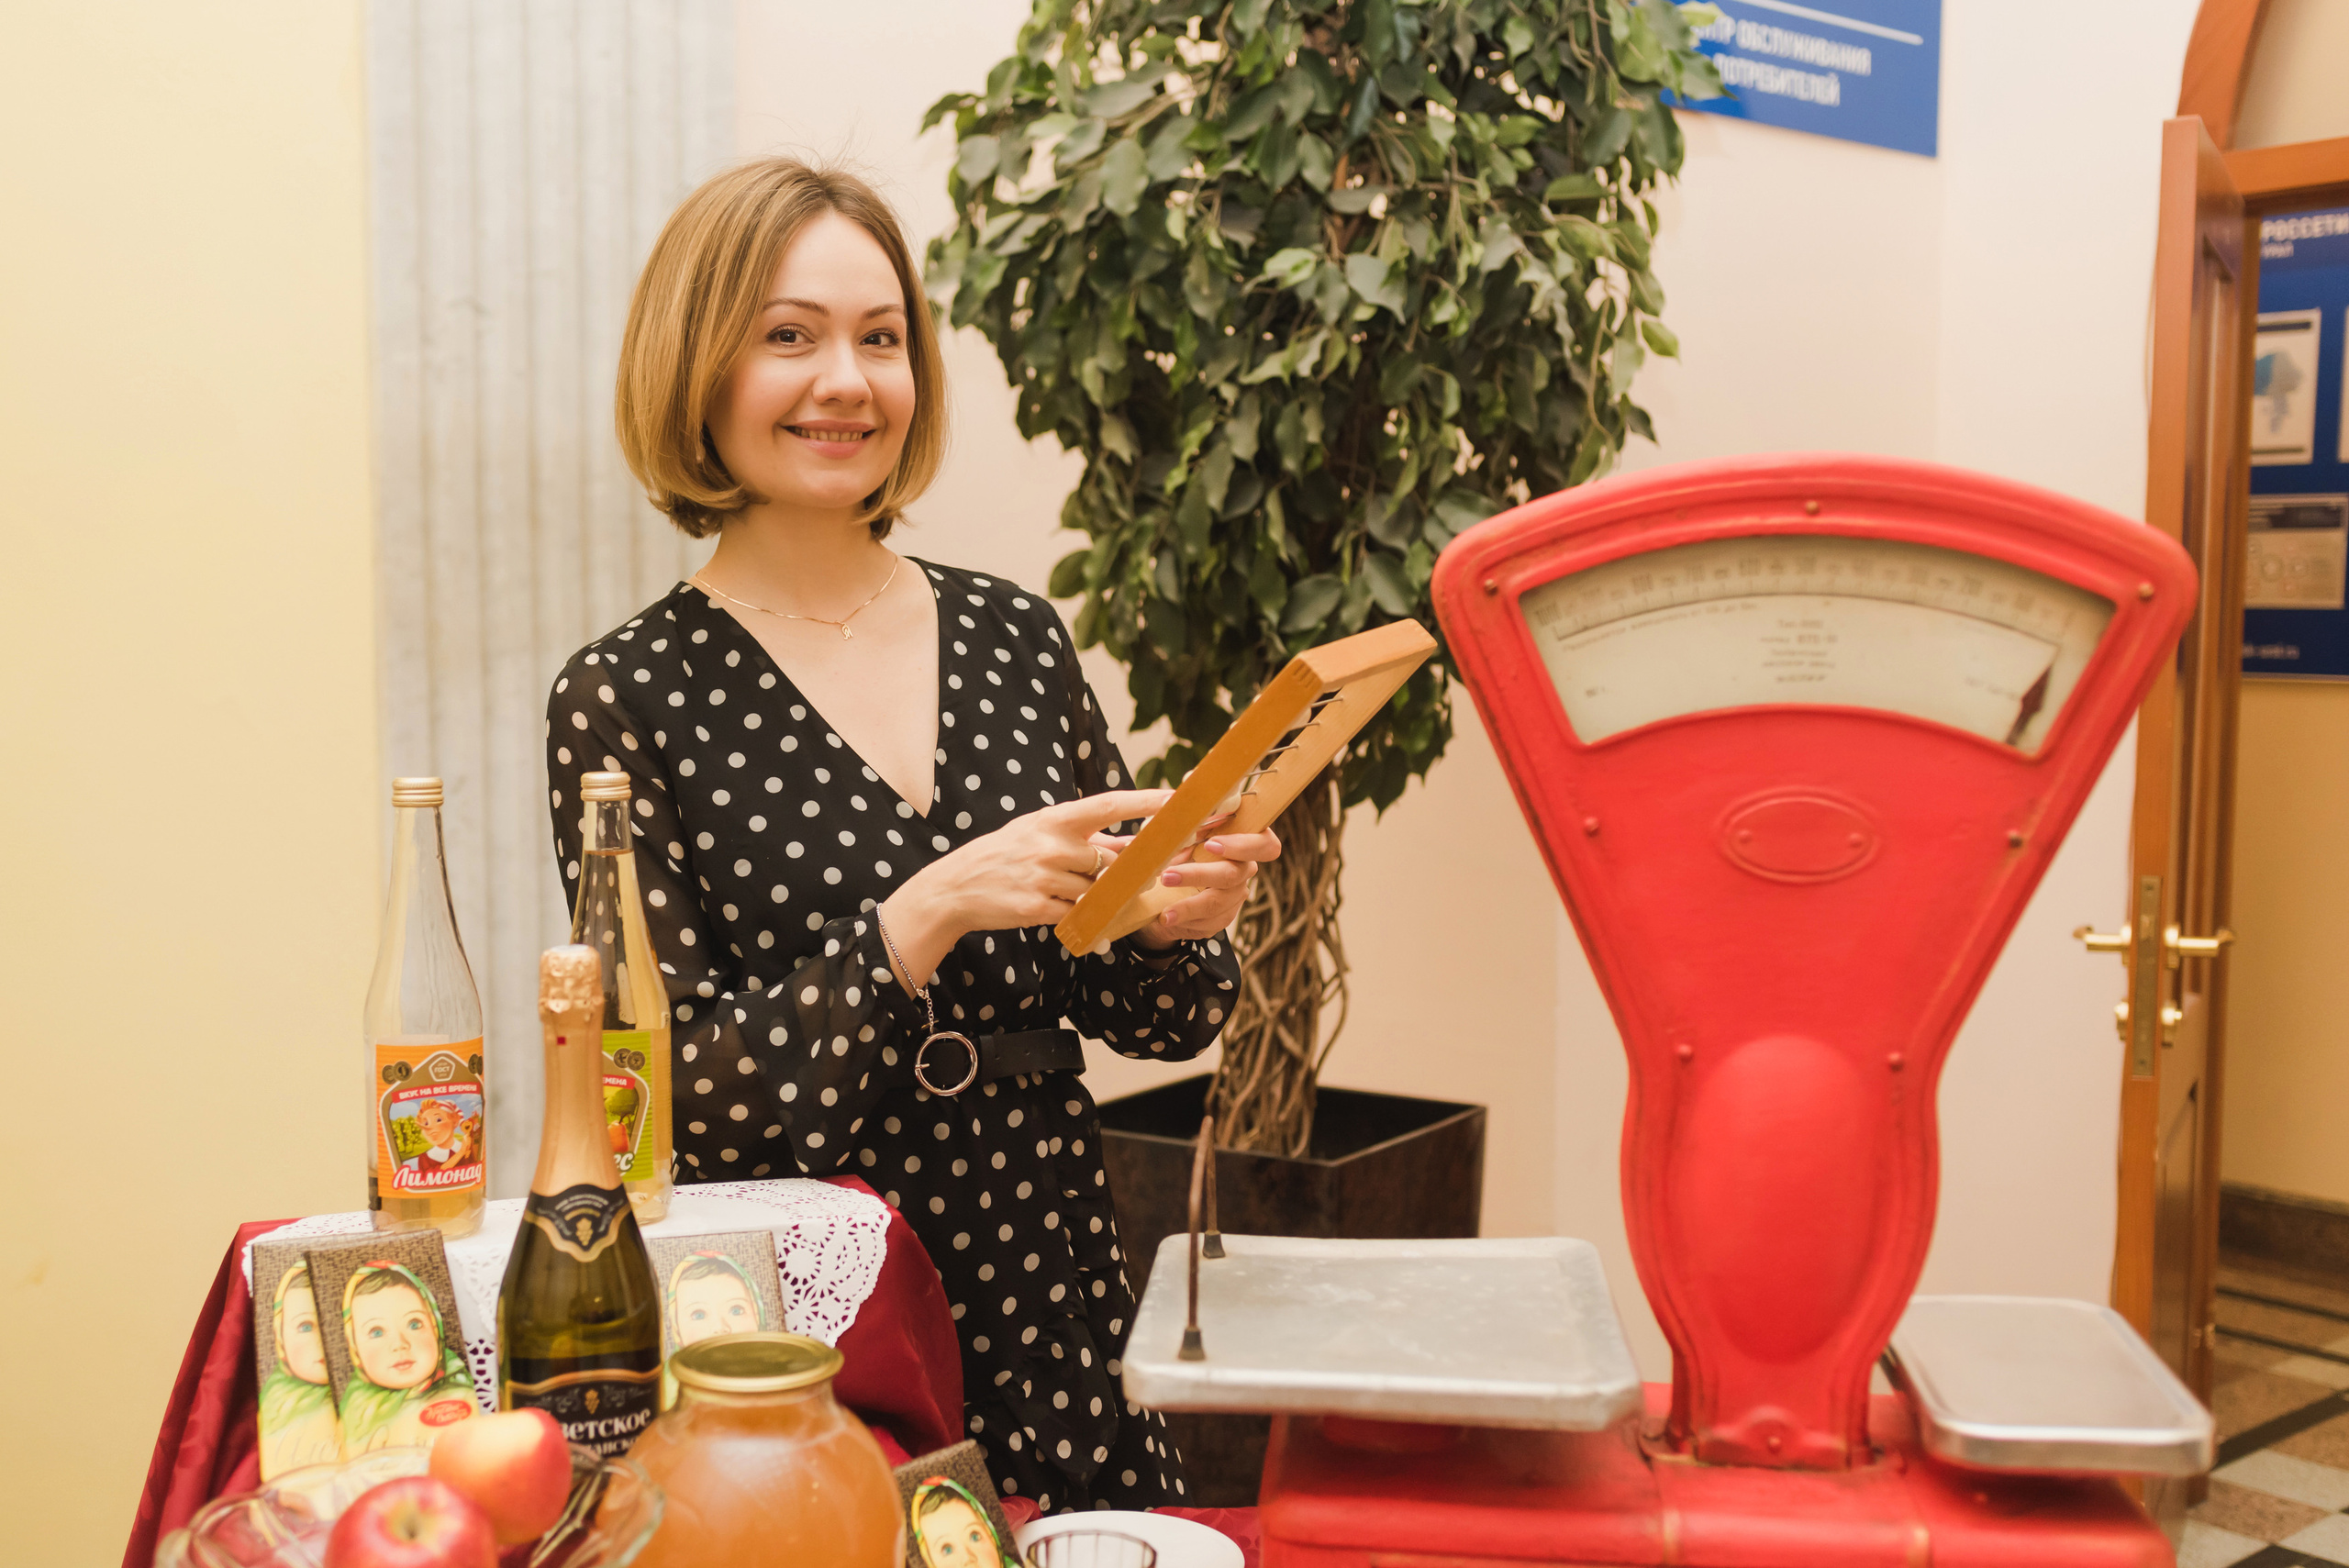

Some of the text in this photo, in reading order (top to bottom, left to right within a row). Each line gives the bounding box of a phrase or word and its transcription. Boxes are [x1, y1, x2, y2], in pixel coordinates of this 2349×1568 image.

[1736, 18, 1872, 77] ОБСЛУЖИВАНИЯ
[398, 1089, 419, 1100] ВКУС
[419, 1087, 432, 1095] НА
[433, 1085, 447, 1095] ВСЕ
[393, 1162, 483, 1189] Лимонад
